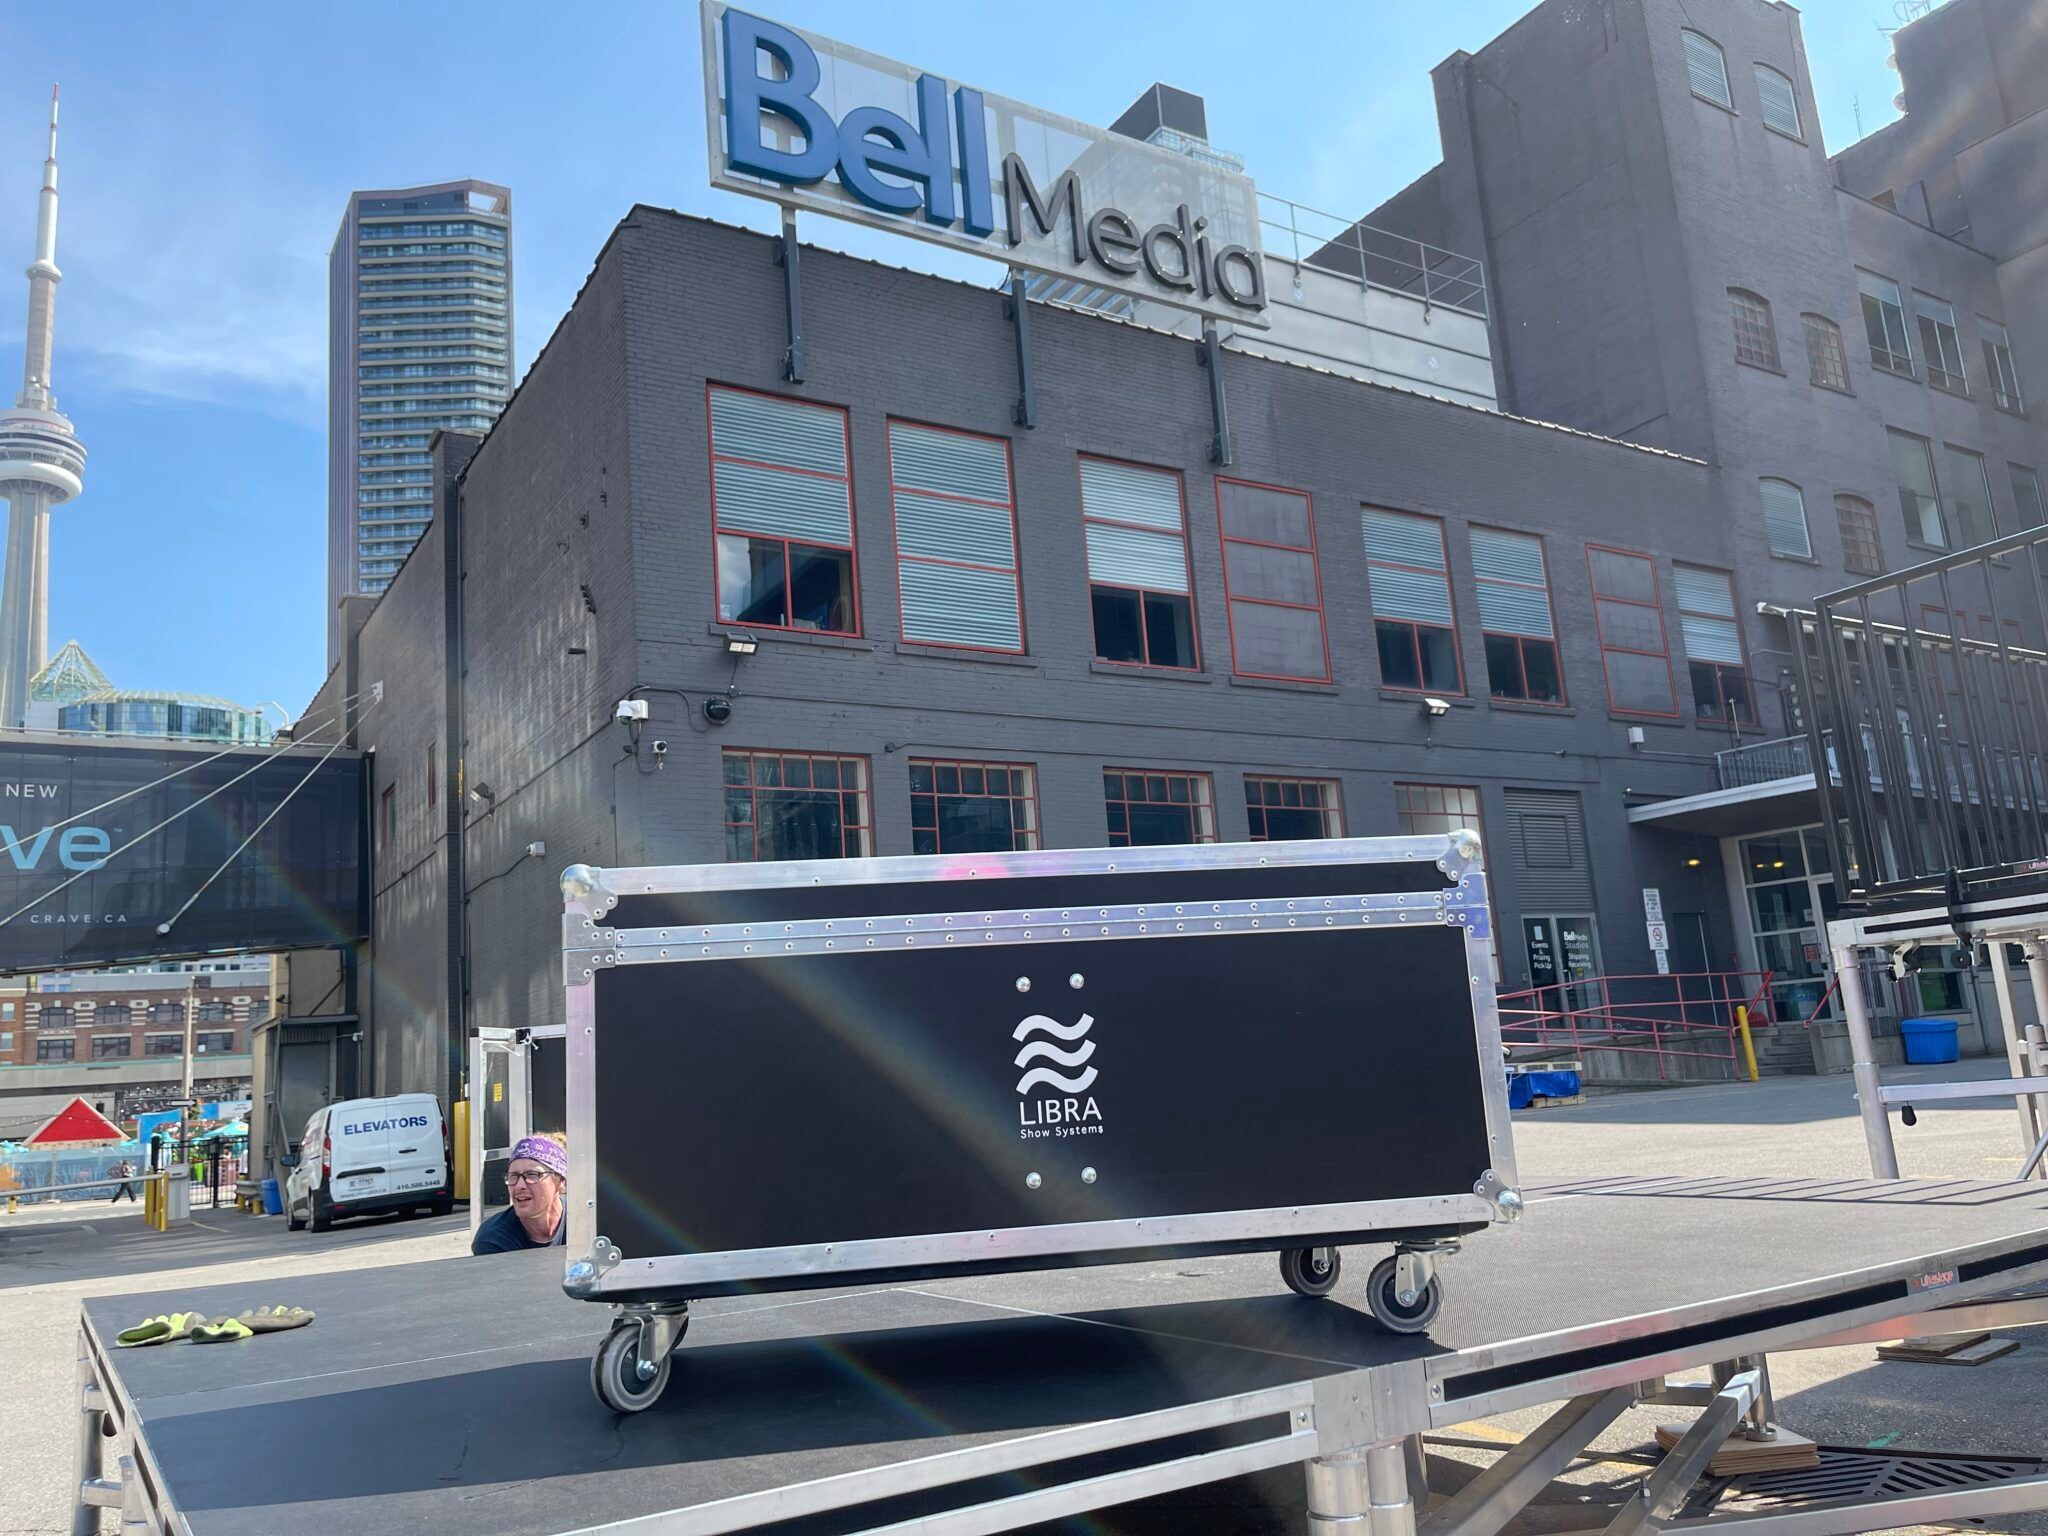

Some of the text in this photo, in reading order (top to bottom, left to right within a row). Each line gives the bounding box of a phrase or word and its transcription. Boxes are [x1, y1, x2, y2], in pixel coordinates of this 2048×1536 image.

[721, 8, 1265, 312] Bell Media
[5, 784, 58, 798] NEW
[30, 914, 127, 923] CRAVE.CA
[1568, 953, 1589, 961] Shipping
[1019, 1096, 1103, 1126] LIBRA
[344, 1116, 428, 1136] ELEVATORS
[1020, 1125, 1104, 1139] Show Systems
